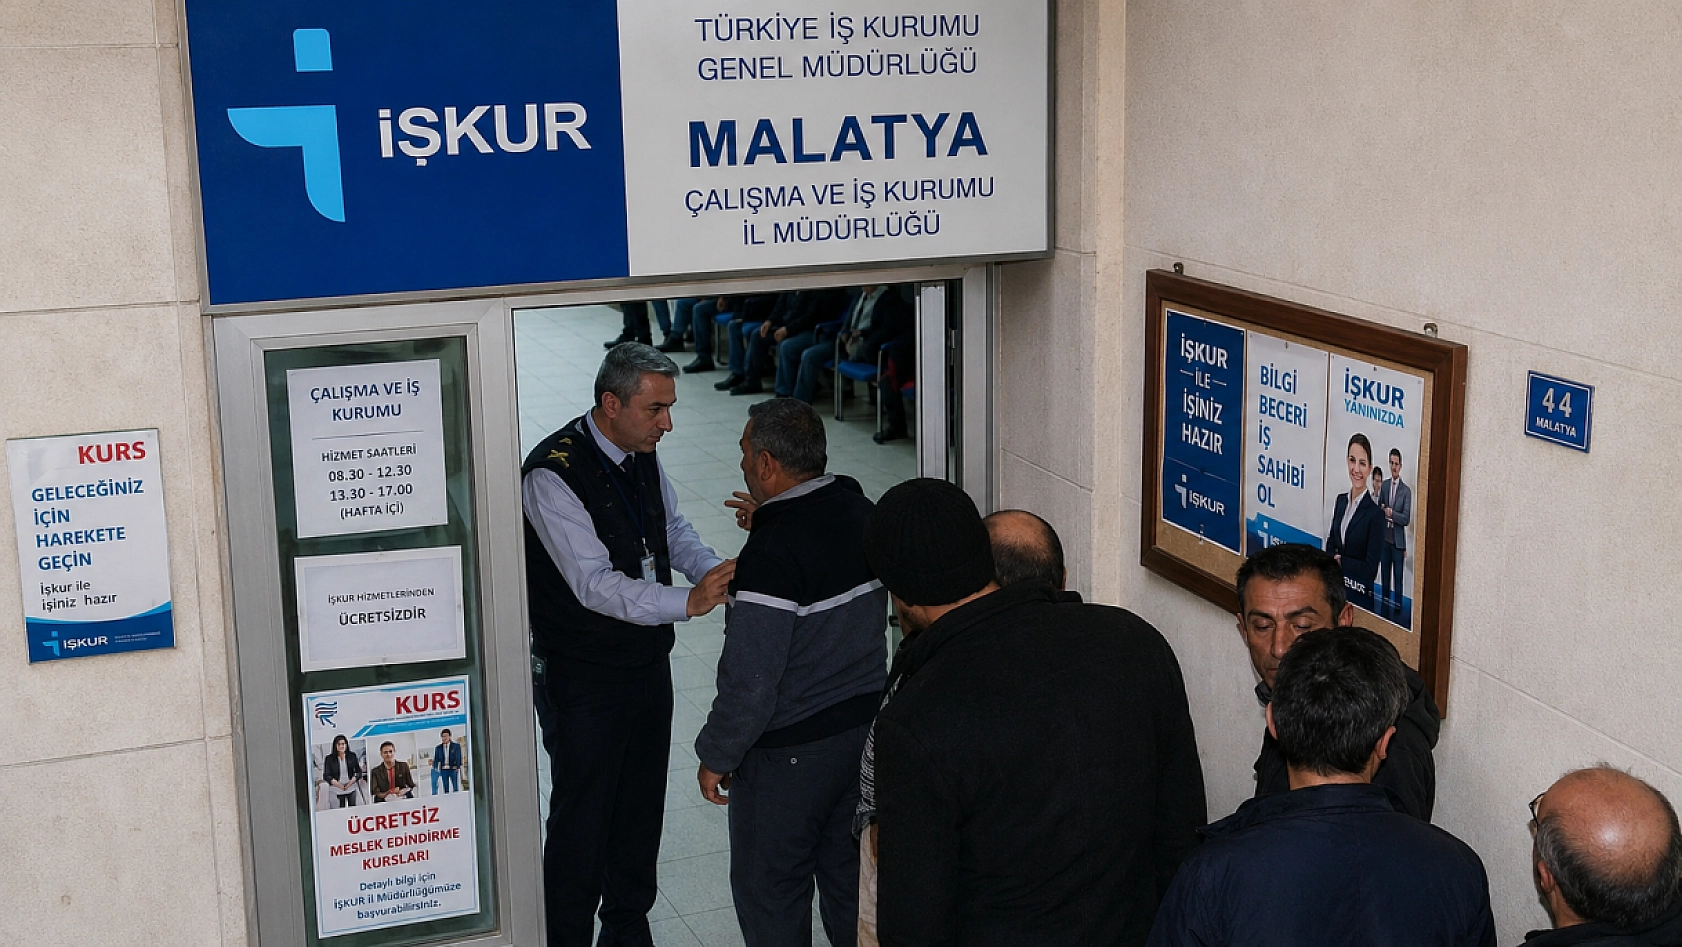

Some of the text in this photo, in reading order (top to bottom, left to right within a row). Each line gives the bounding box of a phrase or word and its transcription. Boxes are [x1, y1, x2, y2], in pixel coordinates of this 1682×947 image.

[694, 12, 980, 45] TÜRKİYE İŞ KURUMU
[698, 47, 977, 81] GENEL MÜDÜRLÜĞÜ
[688, 111, 988, 168] MALATYA
[684, 176, 994, 217] ÇALIŞMA VE İŞ KURUMU
[742, 209, 941, 245] İL MÜDÜRLÜĞÜ
[1181, 332, 1228, 370] İŞKUR
[1195, 366, 1211, 389] İLE
[1260, 362, 1298, 395] BİLGİ
[1344, 367, 1405, 411] İŞKUR
[310, 377, 420, 404] ÇALIŞMA VE İŞ
[332, 403, 402, 422] KURUMU
[1182, 387, 1223, 425] İŞİNİZ
[1259, 394, 1308, 428] BECERİ
[1343, 398, 1405, 429] YANINIZDA
[1181, 422, 1223, 455] HAZIR
[1258, 419, 1271, 451] İŞ
[1536, 416, 1577, 438] MALATYA
[78, 441, 147, 465] KURS
[321, 442, 416, 462] HİZMET SAATLERİ
[328, 468, 364, 482] 08.30
[377, 464, 412, 479] 12.30
[1257, 453, 1305, 490] SAHİBİ
[32, 478, 144, 502] GELECEĞİNİZ
[330, 487, 366, 502] 13.30
[379, 482, 413, 497] 17.00
[1257, 482, 1275, 508] OL
[34, 507, 71, 528] İÇİN
[340, 501, 404, 520] (HAFTA İÇİ)
[36, 526, 127, 549] HAREKETE
[38, 549, 92, 572] GEÇİN
[76, 580, 91, 591] ile
[328, 587, 435, 606] İŞKUR HİZMETLERİNDEN
[84, 594, 117, 606] hazır
[339, 605, 426, 626] ÜCRETSİZDİR
[395, 690, 461, 715] KURS
[347, 805, 440, 835] ÜCRETSİZ
[330, 827, 460, 857] MESLEK EDİNDİRME
[362, 849, 430, 870] KURSLARI
